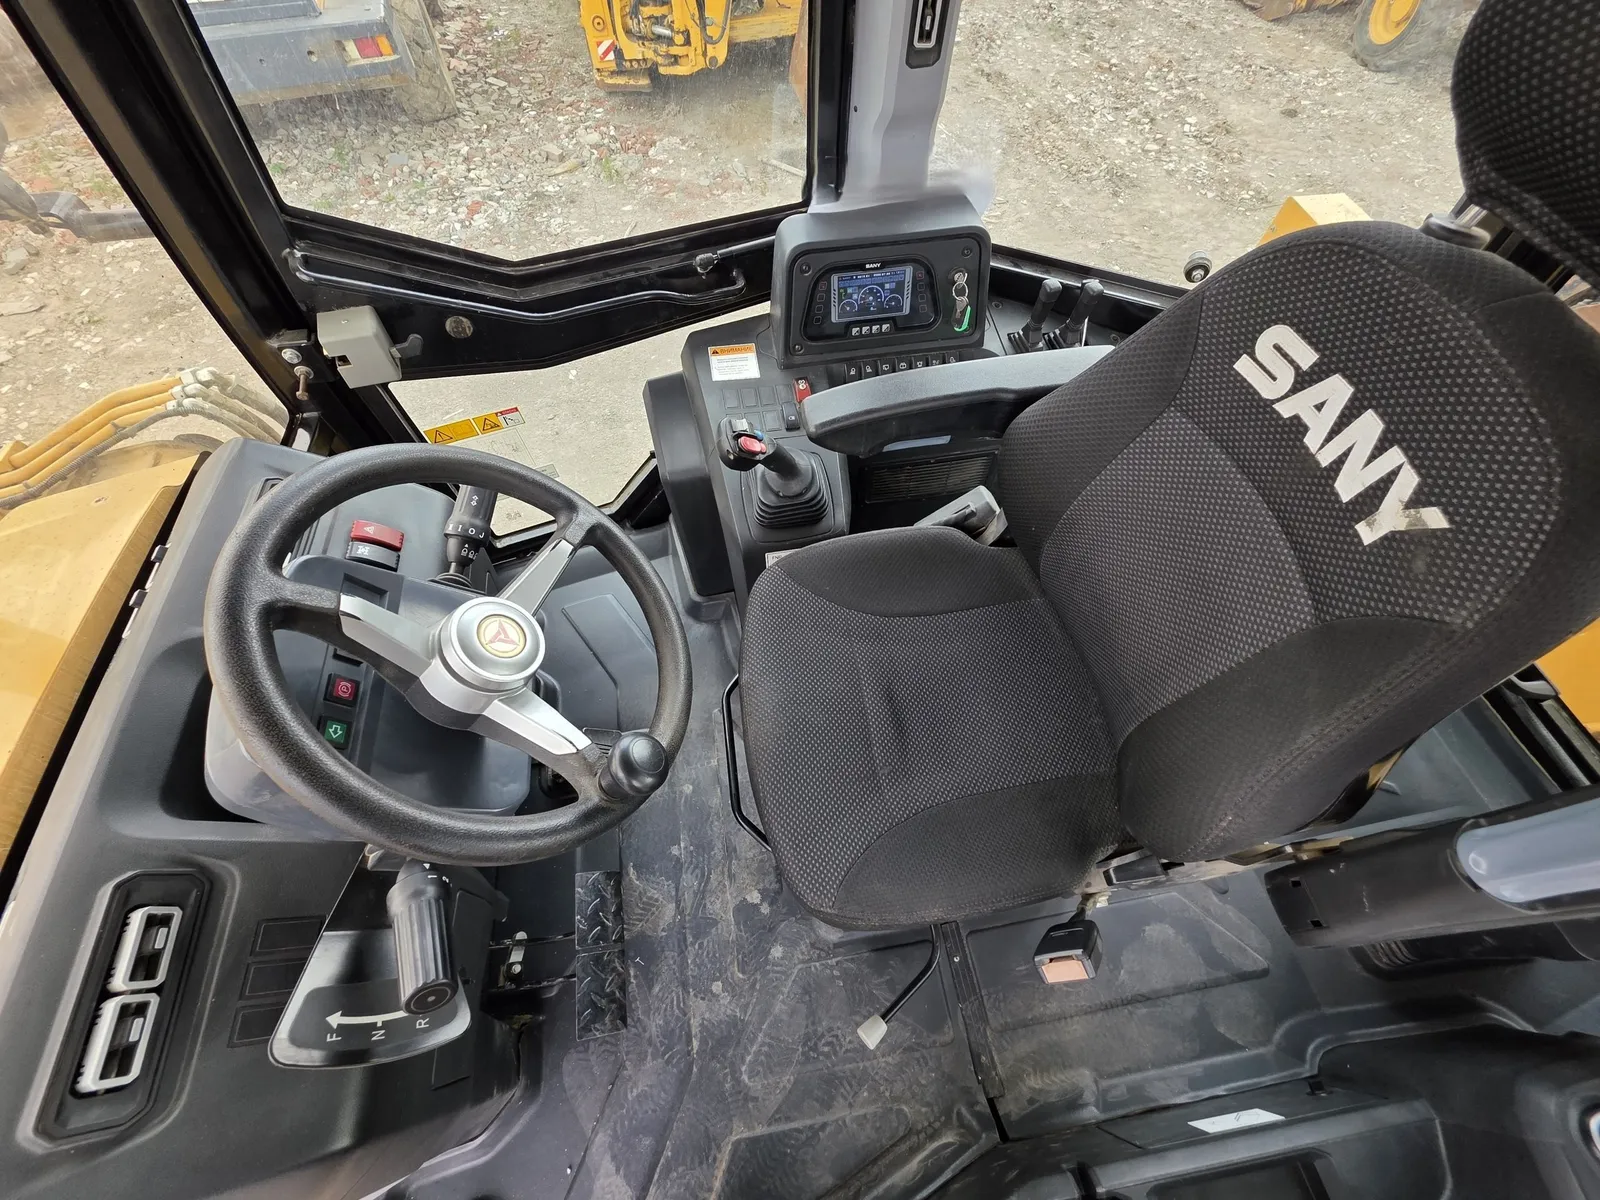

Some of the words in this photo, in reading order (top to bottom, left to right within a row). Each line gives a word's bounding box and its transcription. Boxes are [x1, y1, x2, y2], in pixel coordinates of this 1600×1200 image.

[1233, 324, 1451, 546] SANY
[326, 1033, 342, 1042] F
[371, 1029, 386, 1041] N
[416, 1017, 430, 1029] R
